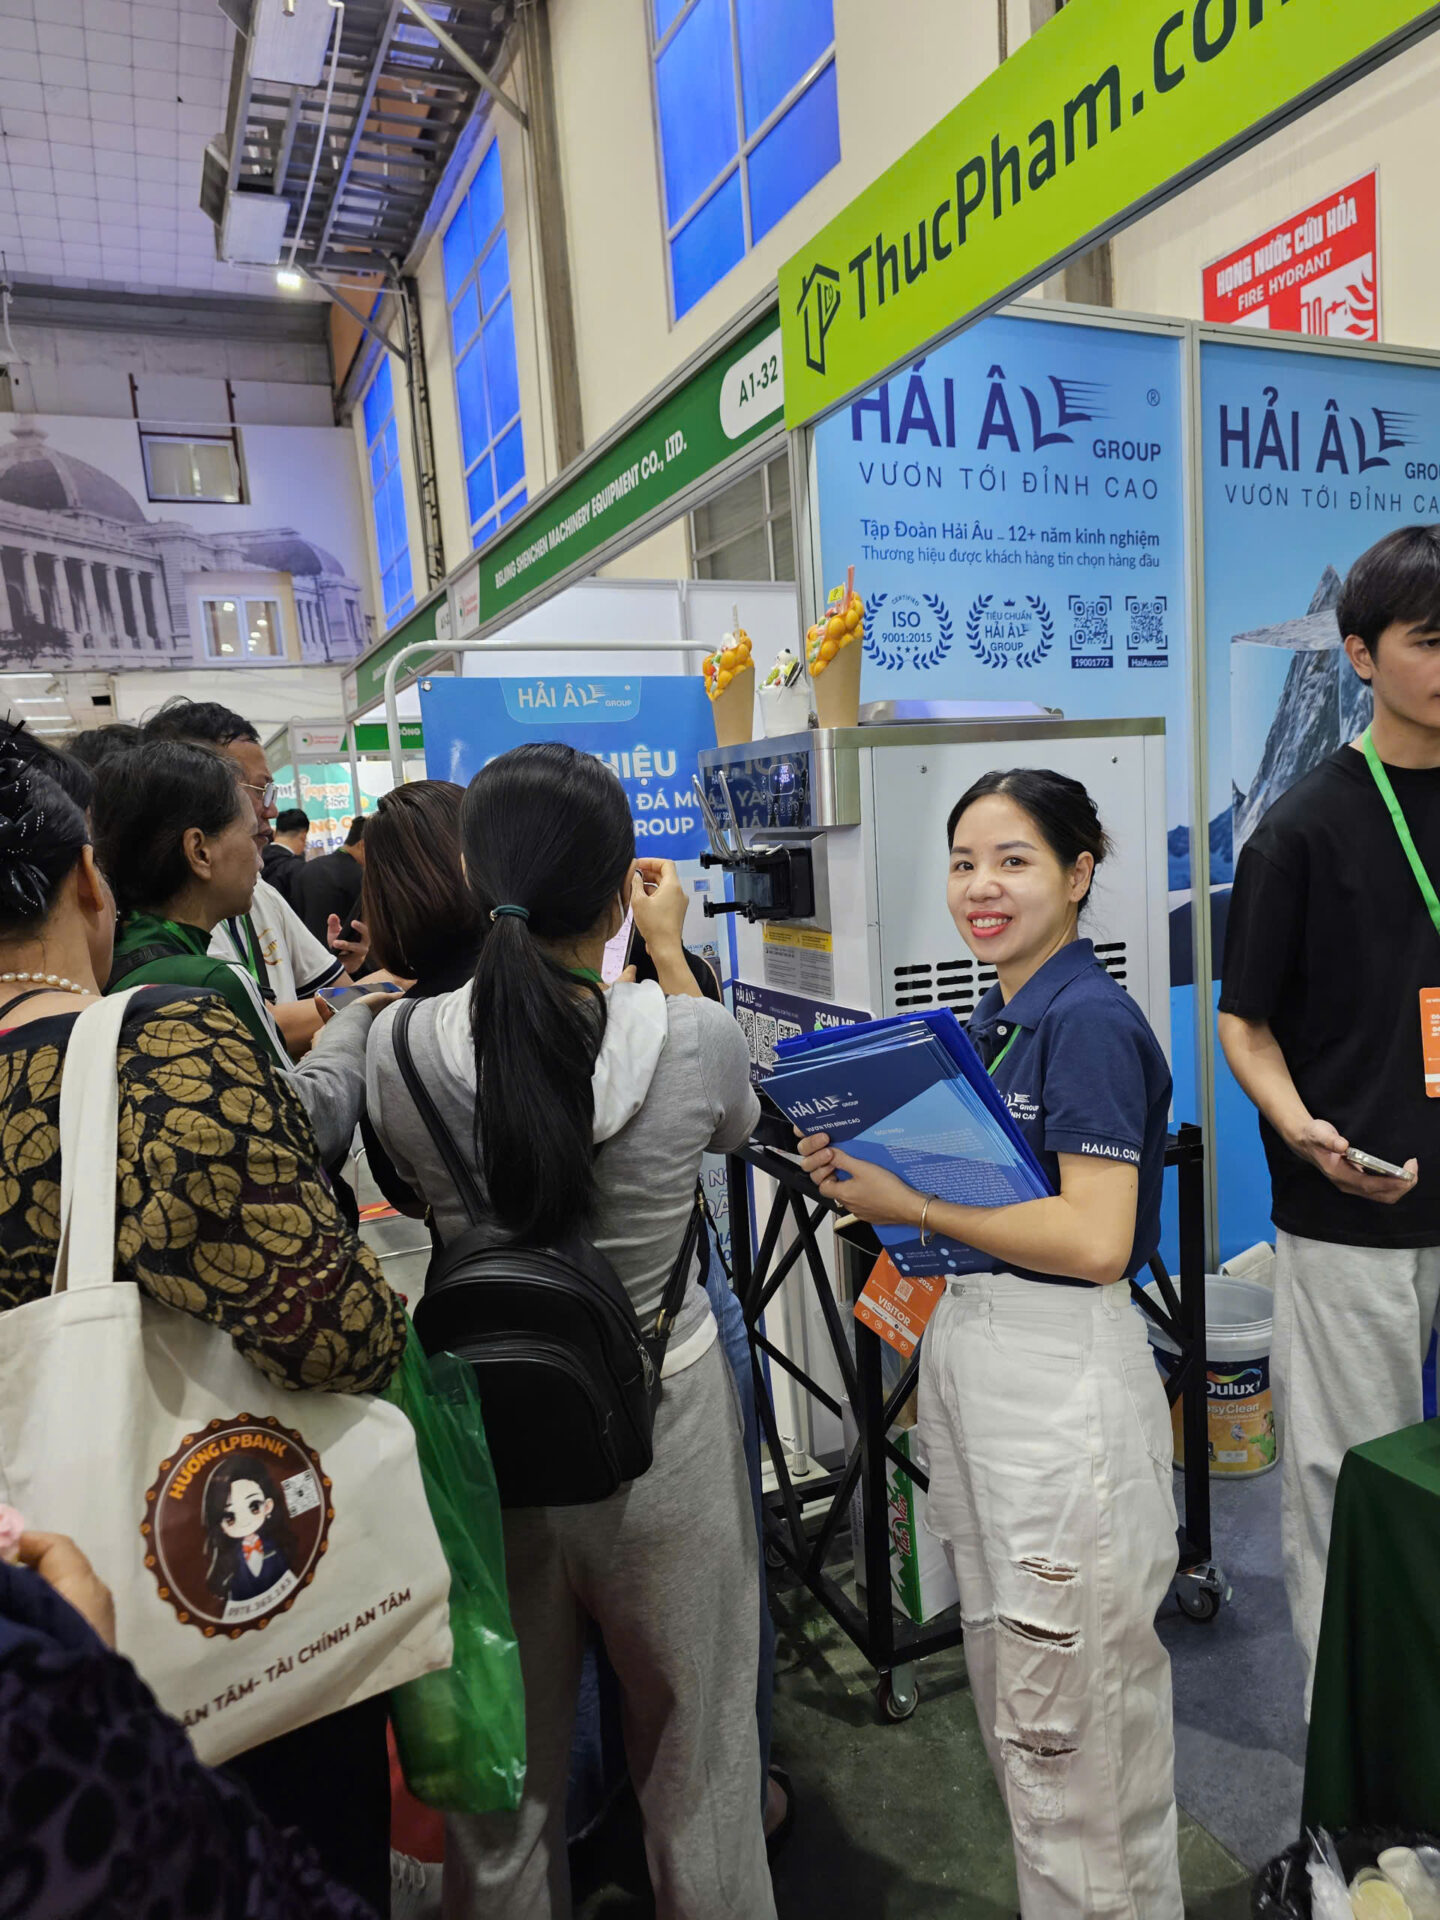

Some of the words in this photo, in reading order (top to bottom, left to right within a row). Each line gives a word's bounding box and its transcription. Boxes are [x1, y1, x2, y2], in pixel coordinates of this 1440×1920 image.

[849, 0, 1290, 321] ThucPham.co
[1216, 254, 1253, 298] HỌNG
[1254, 232, 1293, 277] NƯỚC
[1294, 214, 1324, 255] CỨU
[1326, 195, 1358, 238] HỎA
[1238, 283, 1264, 312] FIRE
[1268, 247, 1333, 297] HYDRANT
[739, 354, 778, 408] A1-32
[1219, 386, 1300, 472] HẢI
[1093, 439, 1162, 462] GROUP
[548, 501, 591, 550] MACHINERY
[590, 462, 640, 518] EQUIPMENT
[640, 450, 664, 480] CO.,
[664, 430, 687, 463] LTD.
[859, 461, 943, 488] VƯƠN
[960, 464, 1006, 492] TỚI
[1022, 465, 1089, 496] ĐỈNH
[1104, 477, 1159, 500] CAO
[1224, 482, 1289, 507] VƯƠN
[1302, 484, 1337, 509] TỚI
[1350, 486, 1402, 512] ĐỈNH
[860, 519, 890, 540] Tập
[894, 520, 937, 539] Đoàn
[942, 522, 968, 540] Hải
[972, 520, 993, 540] Âu
[1008, 525, 1036, 542] 12+
[1041, 527, 1071, 543] năm
[1075, 528, 1106, 545] kinh
[1110, 529, 1160, 549] nghiệm
[861, 545, 915, 564] Thương
[918, 547, 945, 564] hiệu
[949, 548, 982, 565] được
[985, 549, 1022, 564] khách
[1025, 550, 1054, 568] hàng
[1058, 552, 1074, 565] tin
[1077, 552, 1105, 568] chọn
[1109, 553, 1136, 570] hàng
[1139, 553, 1160, 568] đầu
[892, 611, 921, 628] ISO
[985, 620, 1004, 639] HẢI
[881, 632, 933, 643] 9001:2015
[990, 642, 1024, 652] GROUP
[1074, 658, 1110, 668] 19001772
[518, 681, 557, 708] HẢI
[605, 700, 633, 708] GROUP
[636, 787, 669, 810] ĐÁ
[815, 1011, 839, 1027] SCAN
[788, 1101, 815, 1118] HẢI
[918, 1277, 934, 1292] 2026
[878, 1295, 911, 1327] VISITOR
[169, 1443, 220, 1500] HƯƠNG
[220, 1434, 288, 1458] LPBANK
[264, 1655, 294, 1683] TÀI
[298, 1622, 351, 1665] CHÍNH
[354, 1606, 376, 1632] AN
[379, 1587, 412, 1615] TÂM
